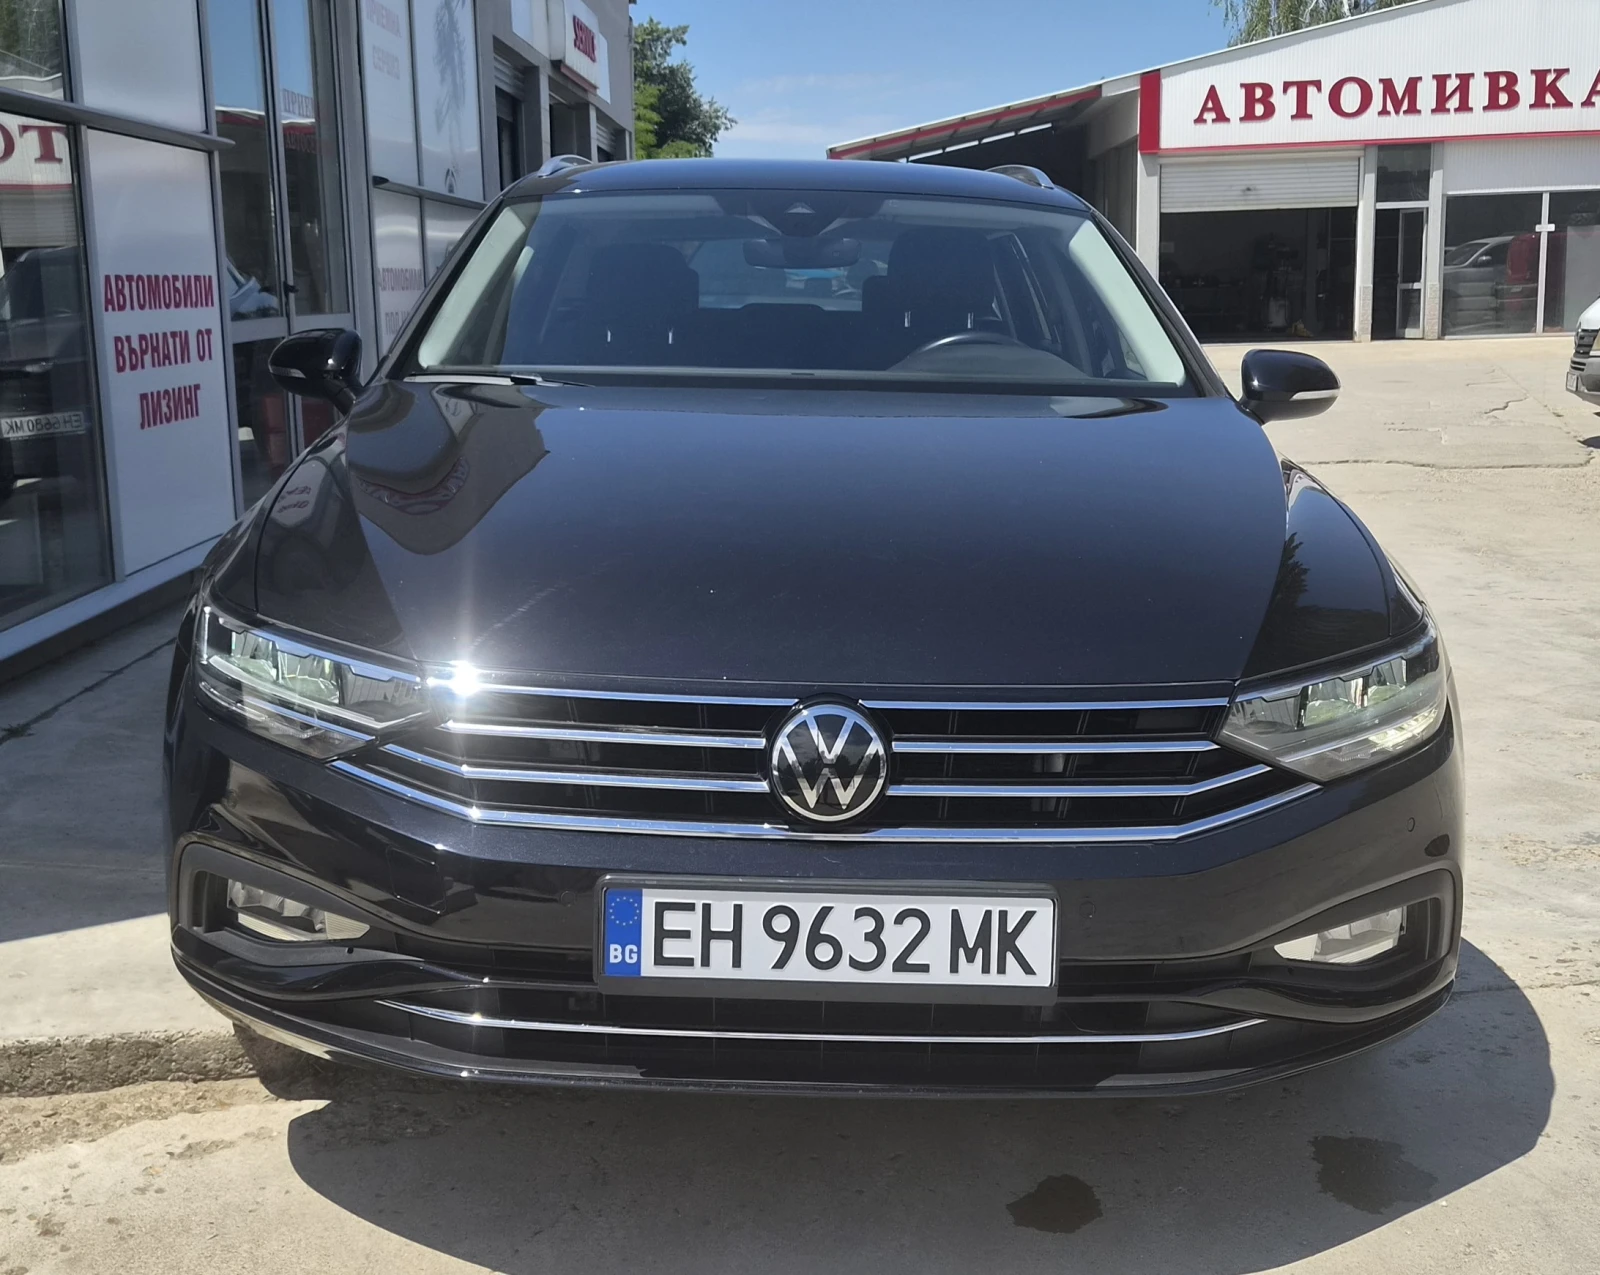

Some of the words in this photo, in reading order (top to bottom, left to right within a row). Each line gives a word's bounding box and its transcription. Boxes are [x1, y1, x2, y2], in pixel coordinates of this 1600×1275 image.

[104, 274, 214, 312] АВТОМОБИЛИ
[114, 329, 191, 373] ВЪРНАТИ
[196, 328, 213, 362] ОТ
[139, 384, 201, 430] ЛИЗИНГ
[609, 943, 638, 965] BG
[653, 901, 743, 969] EH
[762, 904, 931, 973] 9632
[949, 908, 1037, 976] MK
